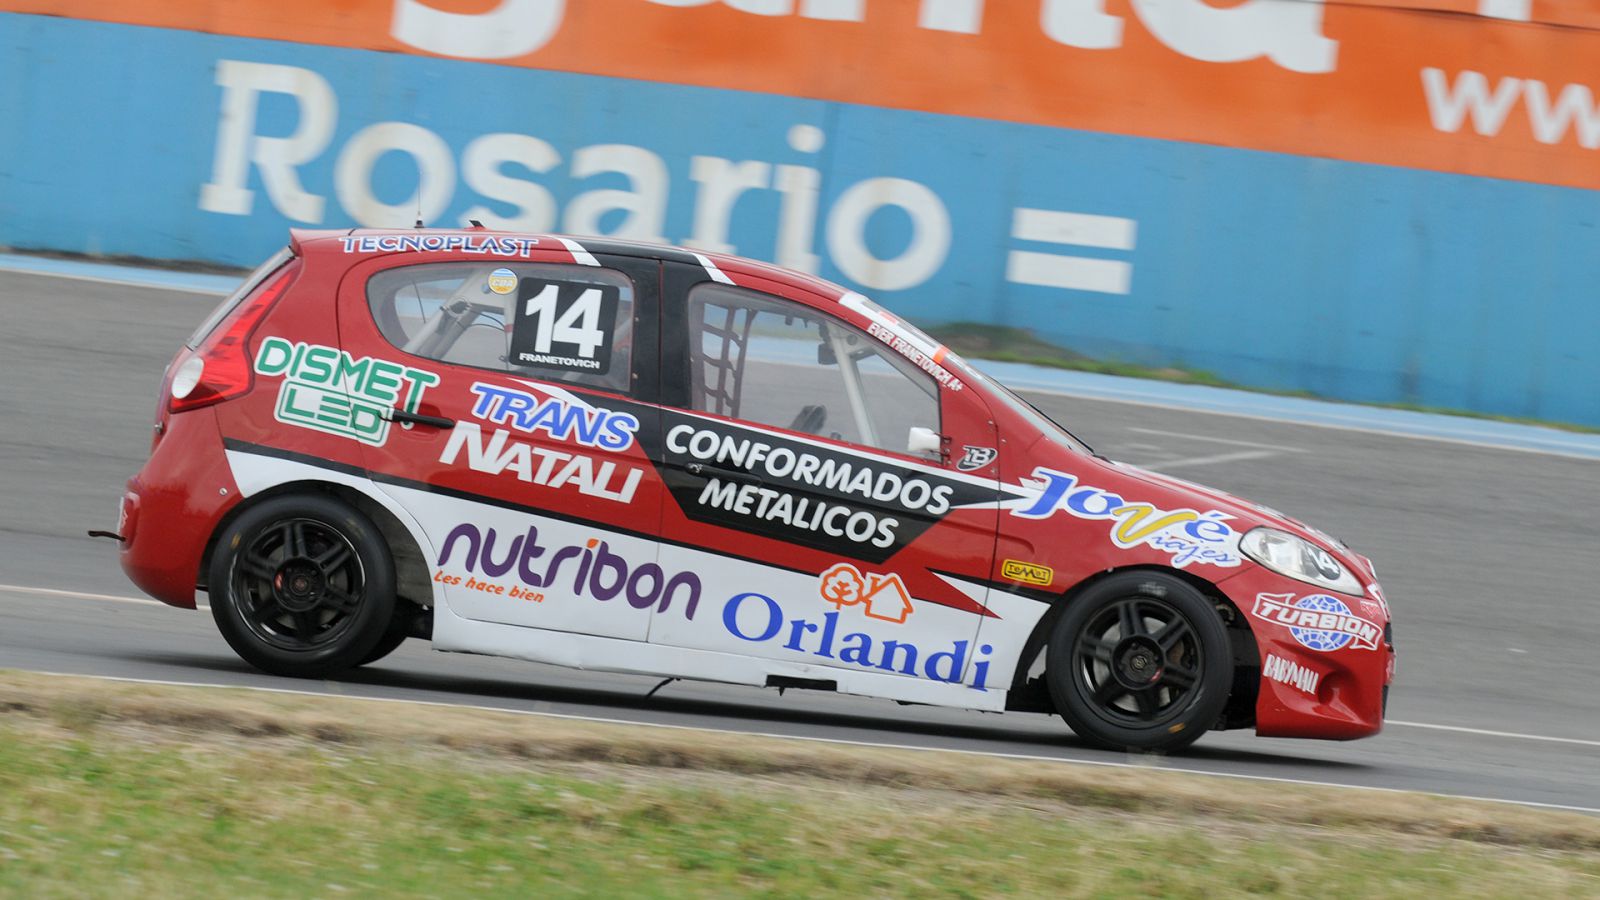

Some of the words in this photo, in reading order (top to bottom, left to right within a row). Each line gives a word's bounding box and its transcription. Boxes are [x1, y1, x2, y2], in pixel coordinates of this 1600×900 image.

[199, 60, 953, 291] Rosario
[338, 235, 539, 258] TECNOPLAST
[525, 284, 604, 358] 14
[867, 321, 896, 346] EVER
[256, 338, 438, 428] DISMET
[519, 352, 600, 369] FRANETOVICH
[283, 388, 383, 435] LED
[471, 382, 640, 452] TRANS
[439, 420, 644, 504] NATALI
[666, 424, 954, 515] CONFORMADOS
[698, 478, 899, 548] METALICOS
[434, 570, 459, 585] Les
[465, 577, 504, 596] hace
[508, 587, 544, 603] bien
[438, 523, 702, 621] nutribon
[722, 592, 993, 692] Orlandi
[1260, 602, 1377, 641] TURBION
